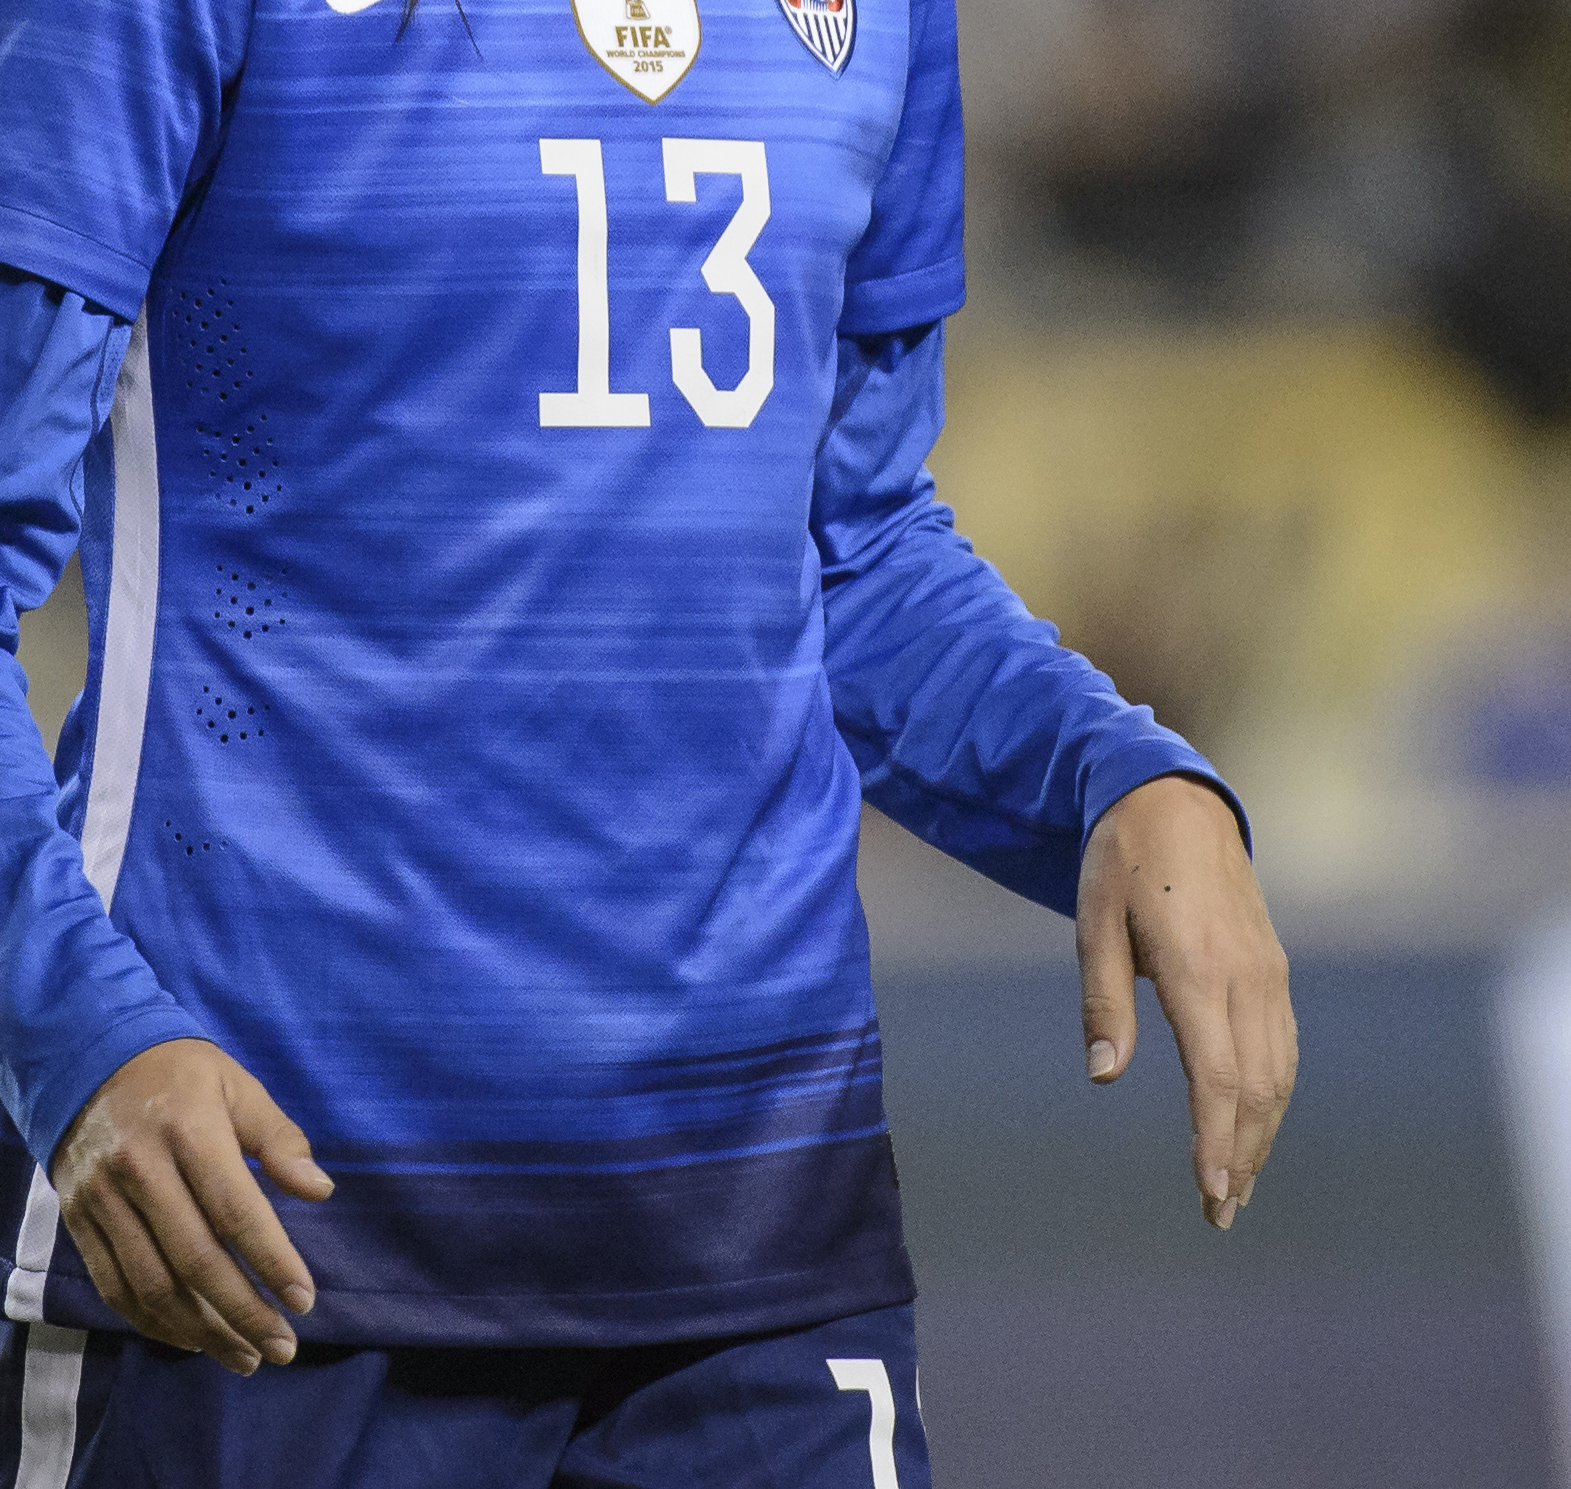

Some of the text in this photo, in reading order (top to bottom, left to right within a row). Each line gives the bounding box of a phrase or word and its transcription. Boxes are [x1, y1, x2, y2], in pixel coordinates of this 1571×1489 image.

[615, 26, 671, 48] FIFA
[606, 50, 636, 58] WORLD
[633, 60, 664, 73] 2015
[538, 137, 776, 428] 13
[826, 1359, 926, 1489] 1
